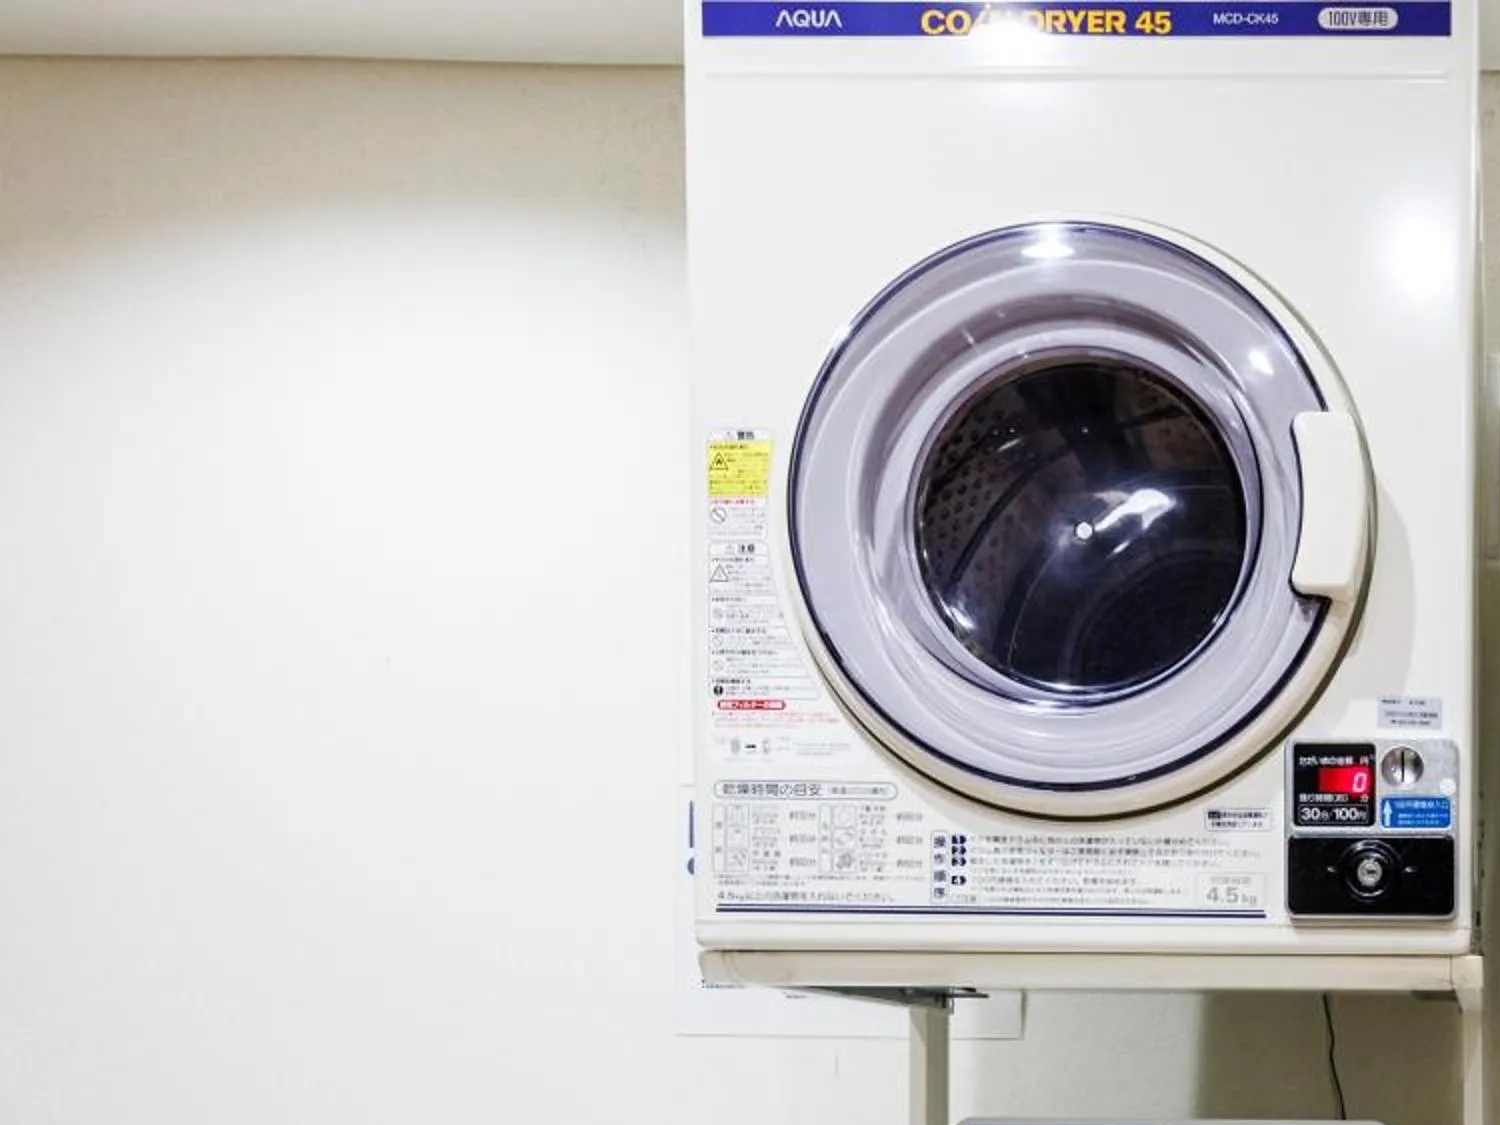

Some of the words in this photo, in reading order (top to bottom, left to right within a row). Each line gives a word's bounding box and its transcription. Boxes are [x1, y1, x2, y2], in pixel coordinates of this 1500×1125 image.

[775, 12, 842, 28] AQUA
[1135, 11, 1172, 35] 45
[1213, 12, 1279, 25] MCD-CK45
[722, 784, 823, 797] 乾燥時間の目安
[1352, 771, 1367, 792] 0
